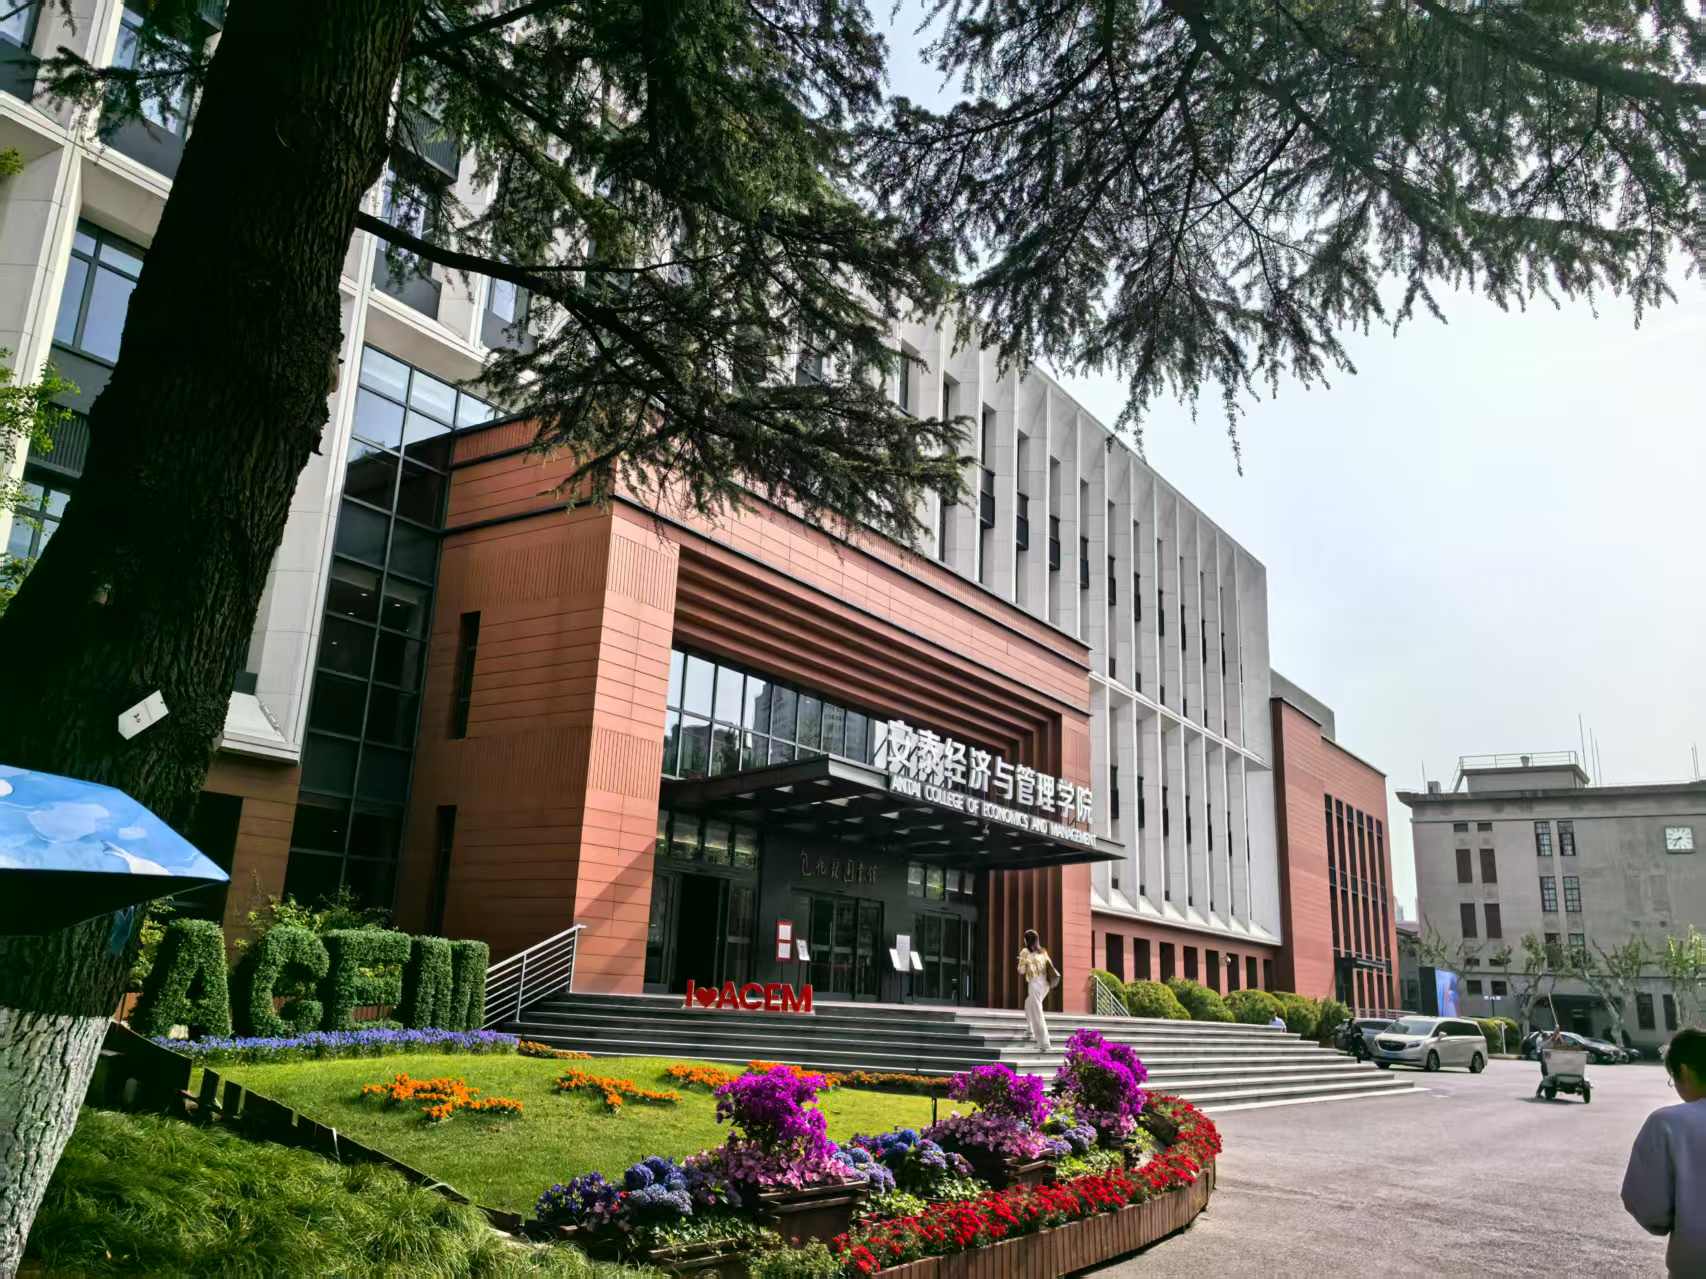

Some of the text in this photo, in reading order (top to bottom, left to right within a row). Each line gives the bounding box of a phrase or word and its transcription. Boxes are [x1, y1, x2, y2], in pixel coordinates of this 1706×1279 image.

[887, 720, 1093, 825] 安泰经济与管理学院
[891, 777, 1096, 847] ANTAI COLLEGE OF ECONOMICS AND MANAGEMENT
[717, 980, 813, 1013] ACEM
